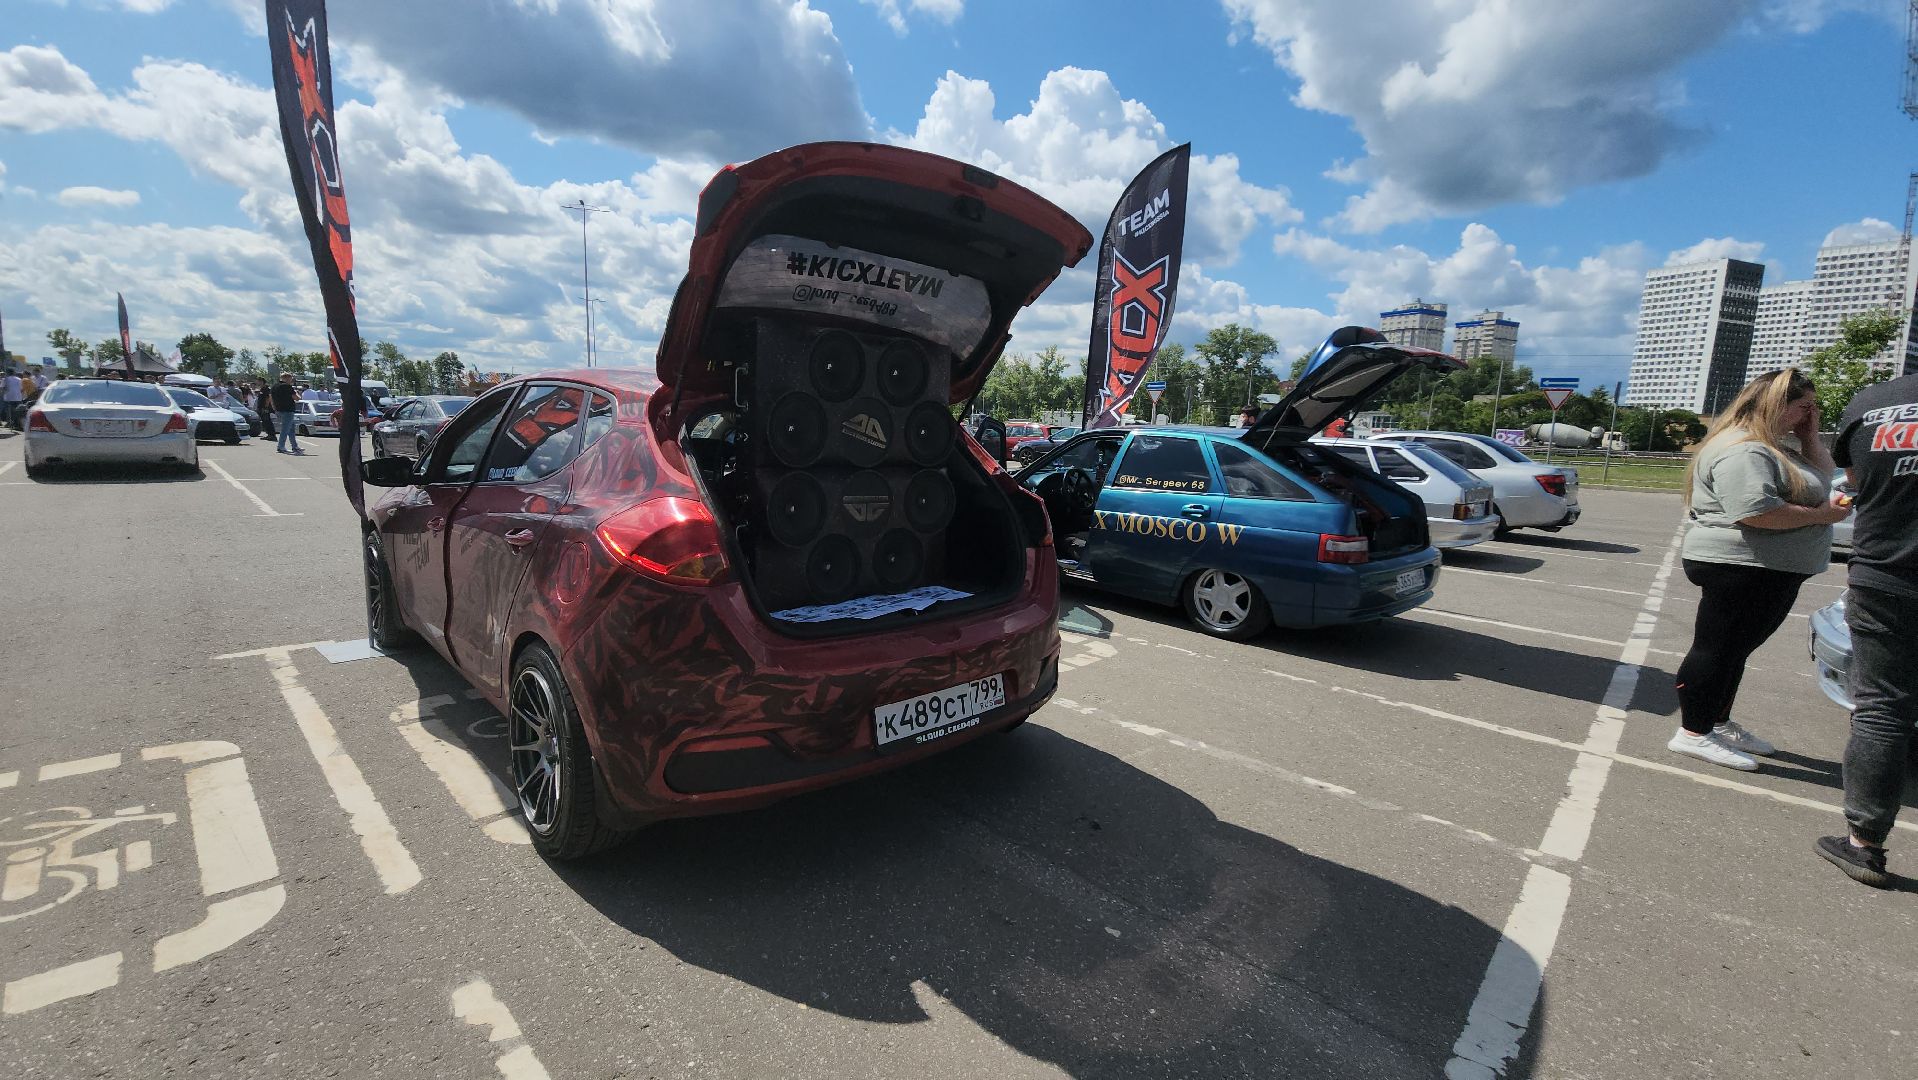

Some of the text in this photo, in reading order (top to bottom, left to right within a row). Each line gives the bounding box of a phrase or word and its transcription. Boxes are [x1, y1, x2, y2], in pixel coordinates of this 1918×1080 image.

[1118, 188, 1170, 236] TEAM
[1865, 405, 1918, 423] GET S
[1871, 422, 1918, 451] KI
[1191, 481, 1205, 490] 68
[1116, 513, 1207, 543] MOSCO
[1216, 522, 1247, 546] W
[971, 677, 998, 703] 799
[980, 700, 994, 710] RUS
